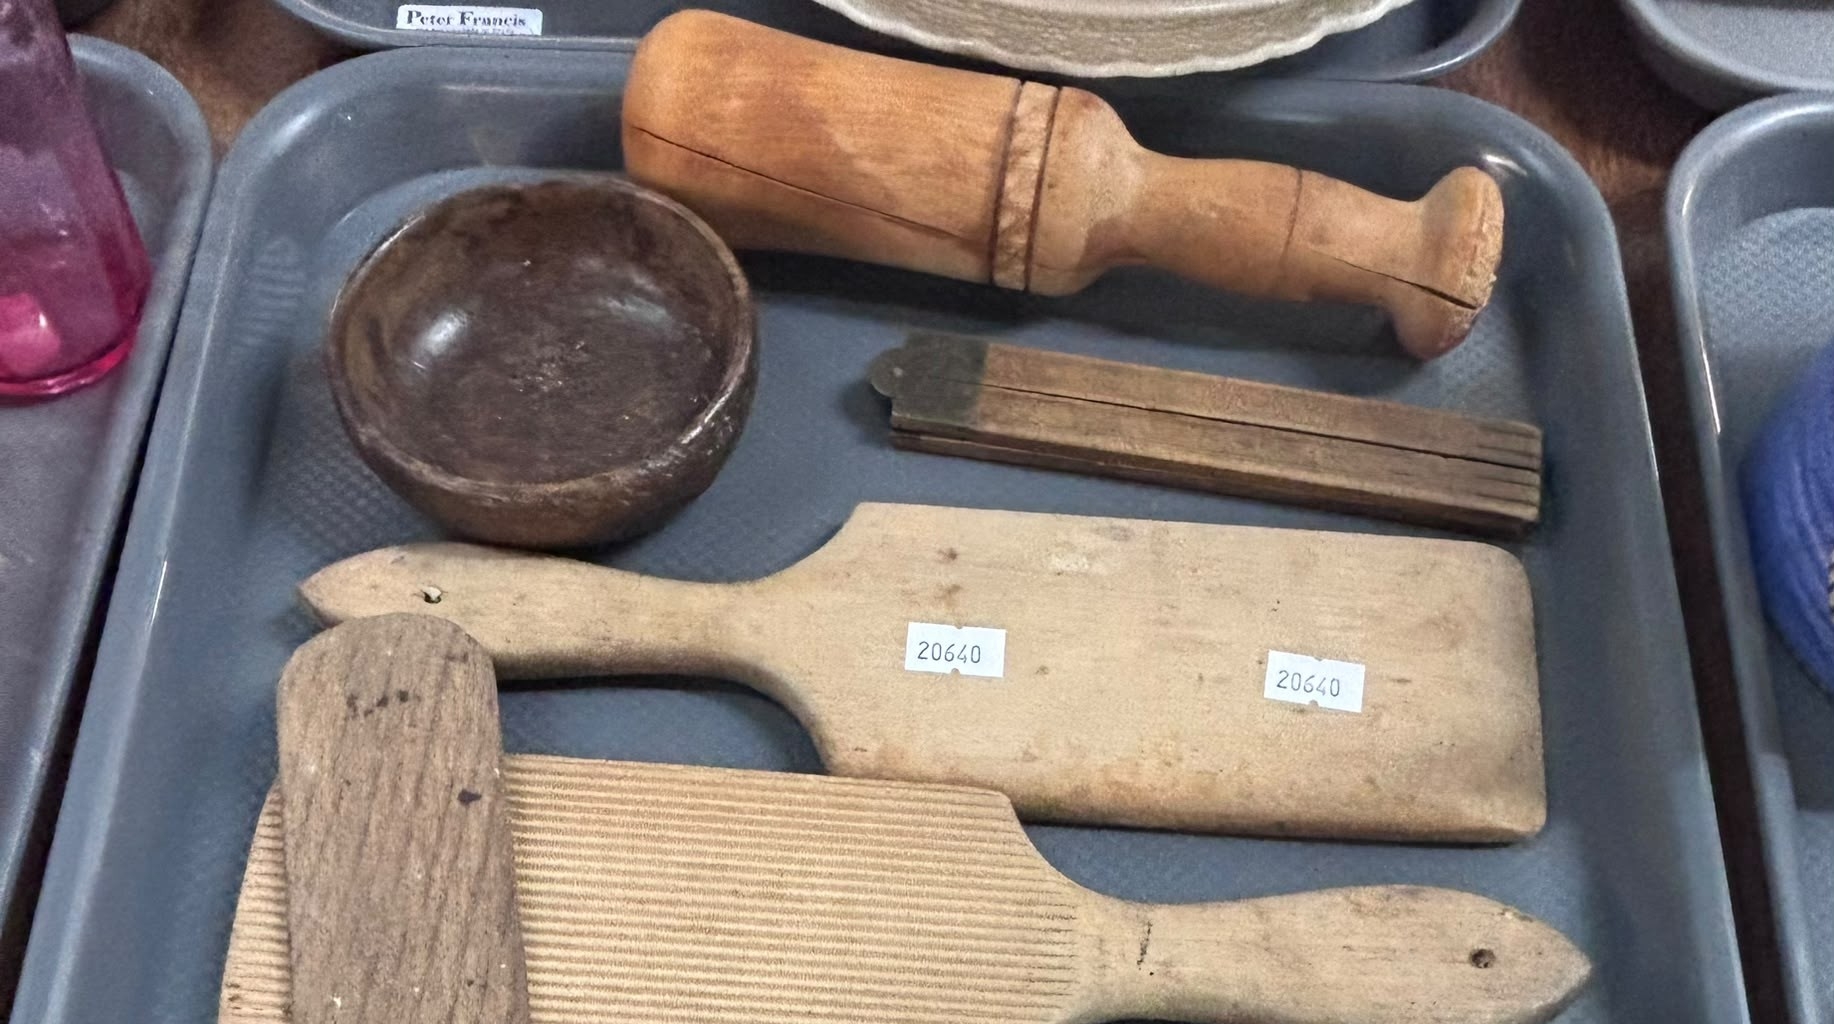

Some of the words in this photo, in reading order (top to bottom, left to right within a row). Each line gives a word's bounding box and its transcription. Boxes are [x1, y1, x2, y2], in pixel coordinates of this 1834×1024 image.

[406, 10, 452, 26] Peter
[459, 11, 527, 27] Francis
[916, 640, 982, 664] 20640
[1275, 669, 1341, 698] 20640
